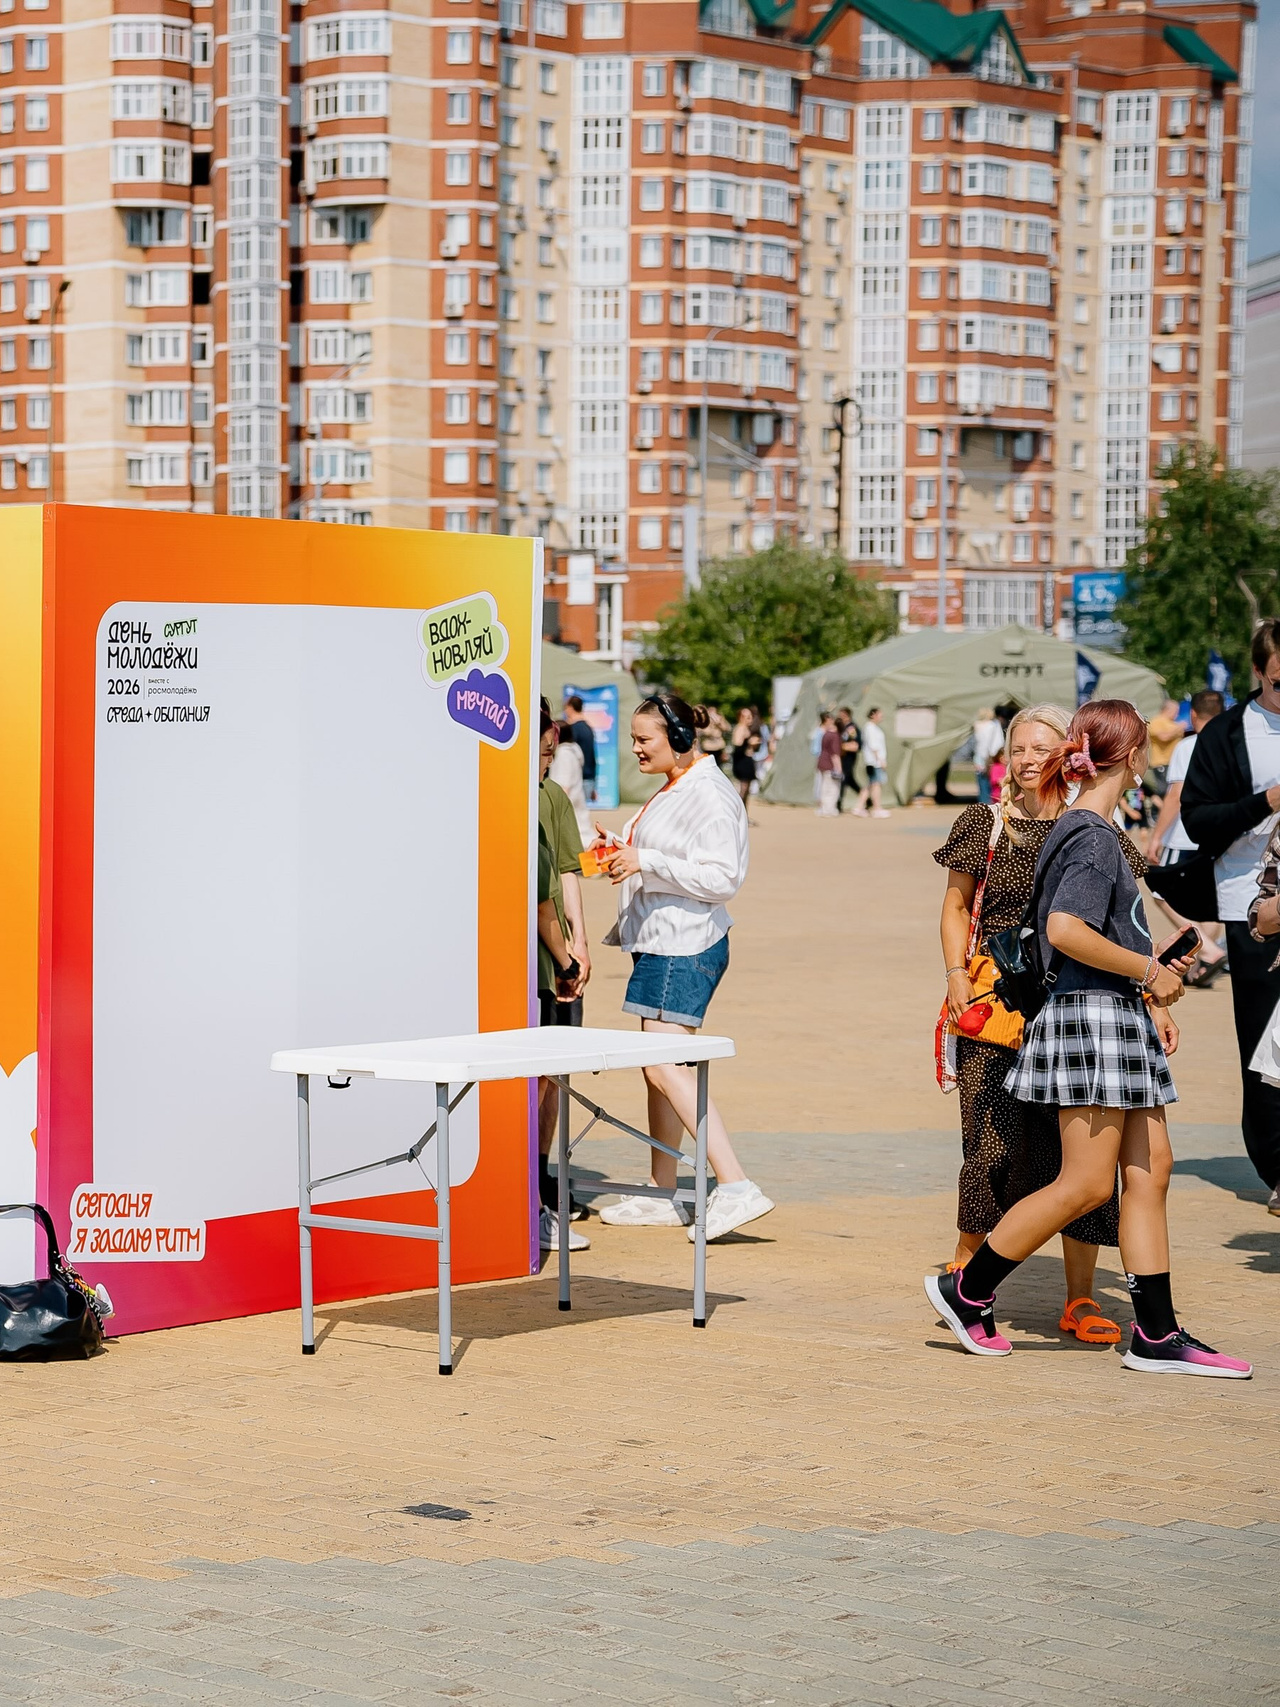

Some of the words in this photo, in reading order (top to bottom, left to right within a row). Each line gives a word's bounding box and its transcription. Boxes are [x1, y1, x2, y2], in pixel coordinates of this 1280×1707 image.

[107, 621, 152, 644] ДЕНЬ
[164, 619, 198, 637] СУРГУТ
[428, 611, 472, 646] ВДОХ-
[107, 642, 198, 669] МОЛОДЁЖИ
[432, 626, 494, 674] НОВЛЯЙ
[107, 679, 140, 695] 2026
[148, 686, 198, 698] росмолодёжь
[107, 706, 144, 723] СРЕДА
[153, 706, 211, 723] ОБИТАНИЯ
[456, 690, 509, 731] МЕЧТАЙ
[76, 1192, 152, 1218] СЕГОДНЯ
[73, 1228, 88, 1253] Я
[90, 1228, 152, 1253] ЗАДАЮ
[156, 1228, 200, 1252] РИТМ
